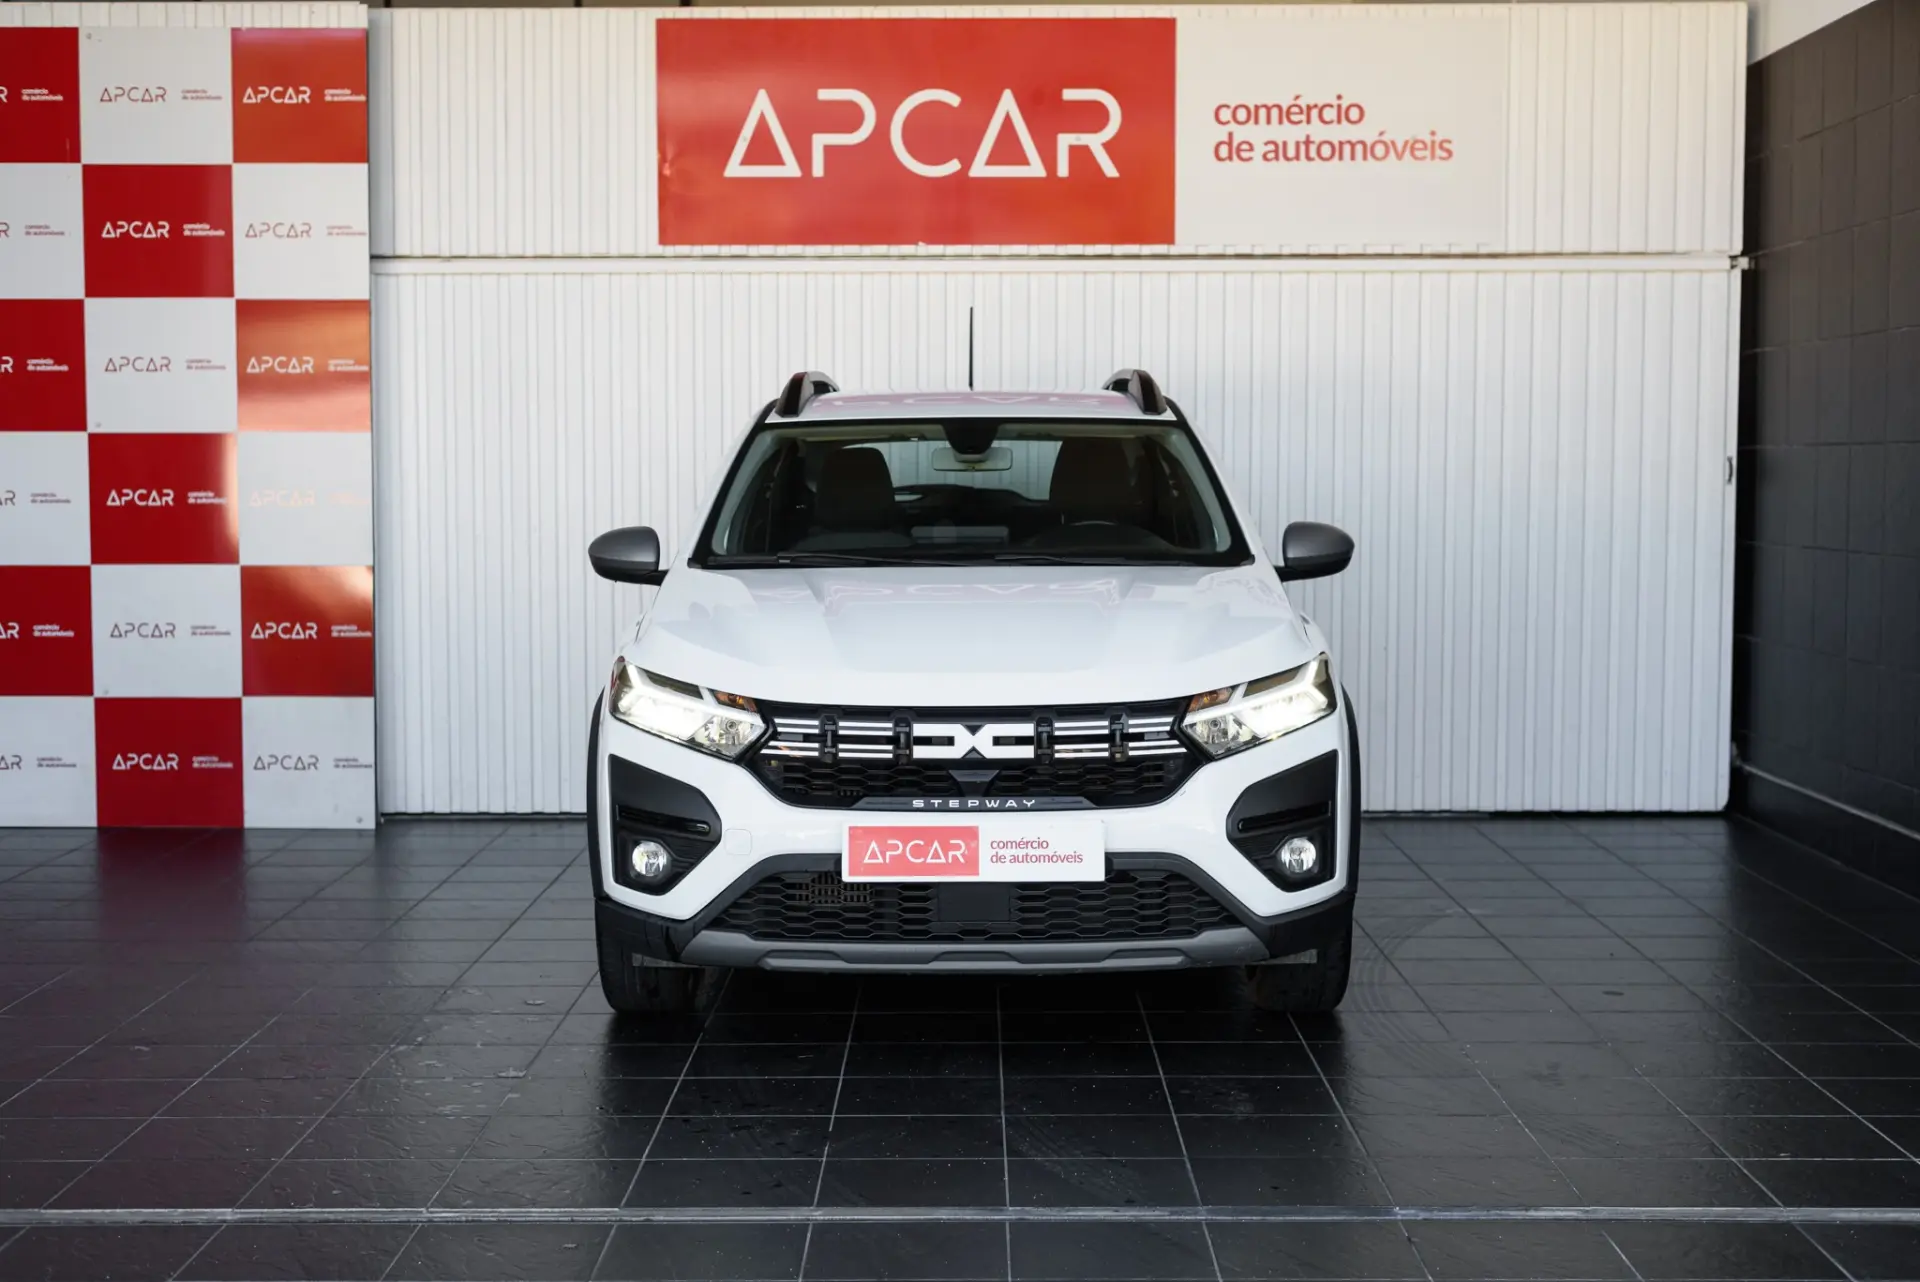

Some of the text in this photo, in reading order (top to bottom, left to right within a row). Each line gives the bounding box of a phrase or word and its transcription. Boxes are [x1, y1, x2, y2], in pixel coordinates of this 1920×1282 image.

[100, 86, 167, 103] APCAR
[243, 86, 311, 104] APCAR
[1214, 94, 1365, 126] comércio
[724, 88, 1122, 178] APCAR
[1214, 131, 1454, 163] de automóveis
[102, 221, 170, 239] APCAR
[245, 221, 313, 239] APCAR
[105, 356, 172, 374] APCAR
[246, 355, 314, 373] APCAR
[107, 489, 175, 507] APCAR
[110, 622, 177, 639] APCAR
[251, 622, 319, 639] APCAR
[113, 754, 180, 770] APCAR
[253, 754, 320, 771] APCAR
[912, 799, 1037, 808] STEPWAY
[863, 839, 966, 864] APCAR
[990, 837, 1050, 850] comércio
[990, 850, 1084, 864] de automóveis
